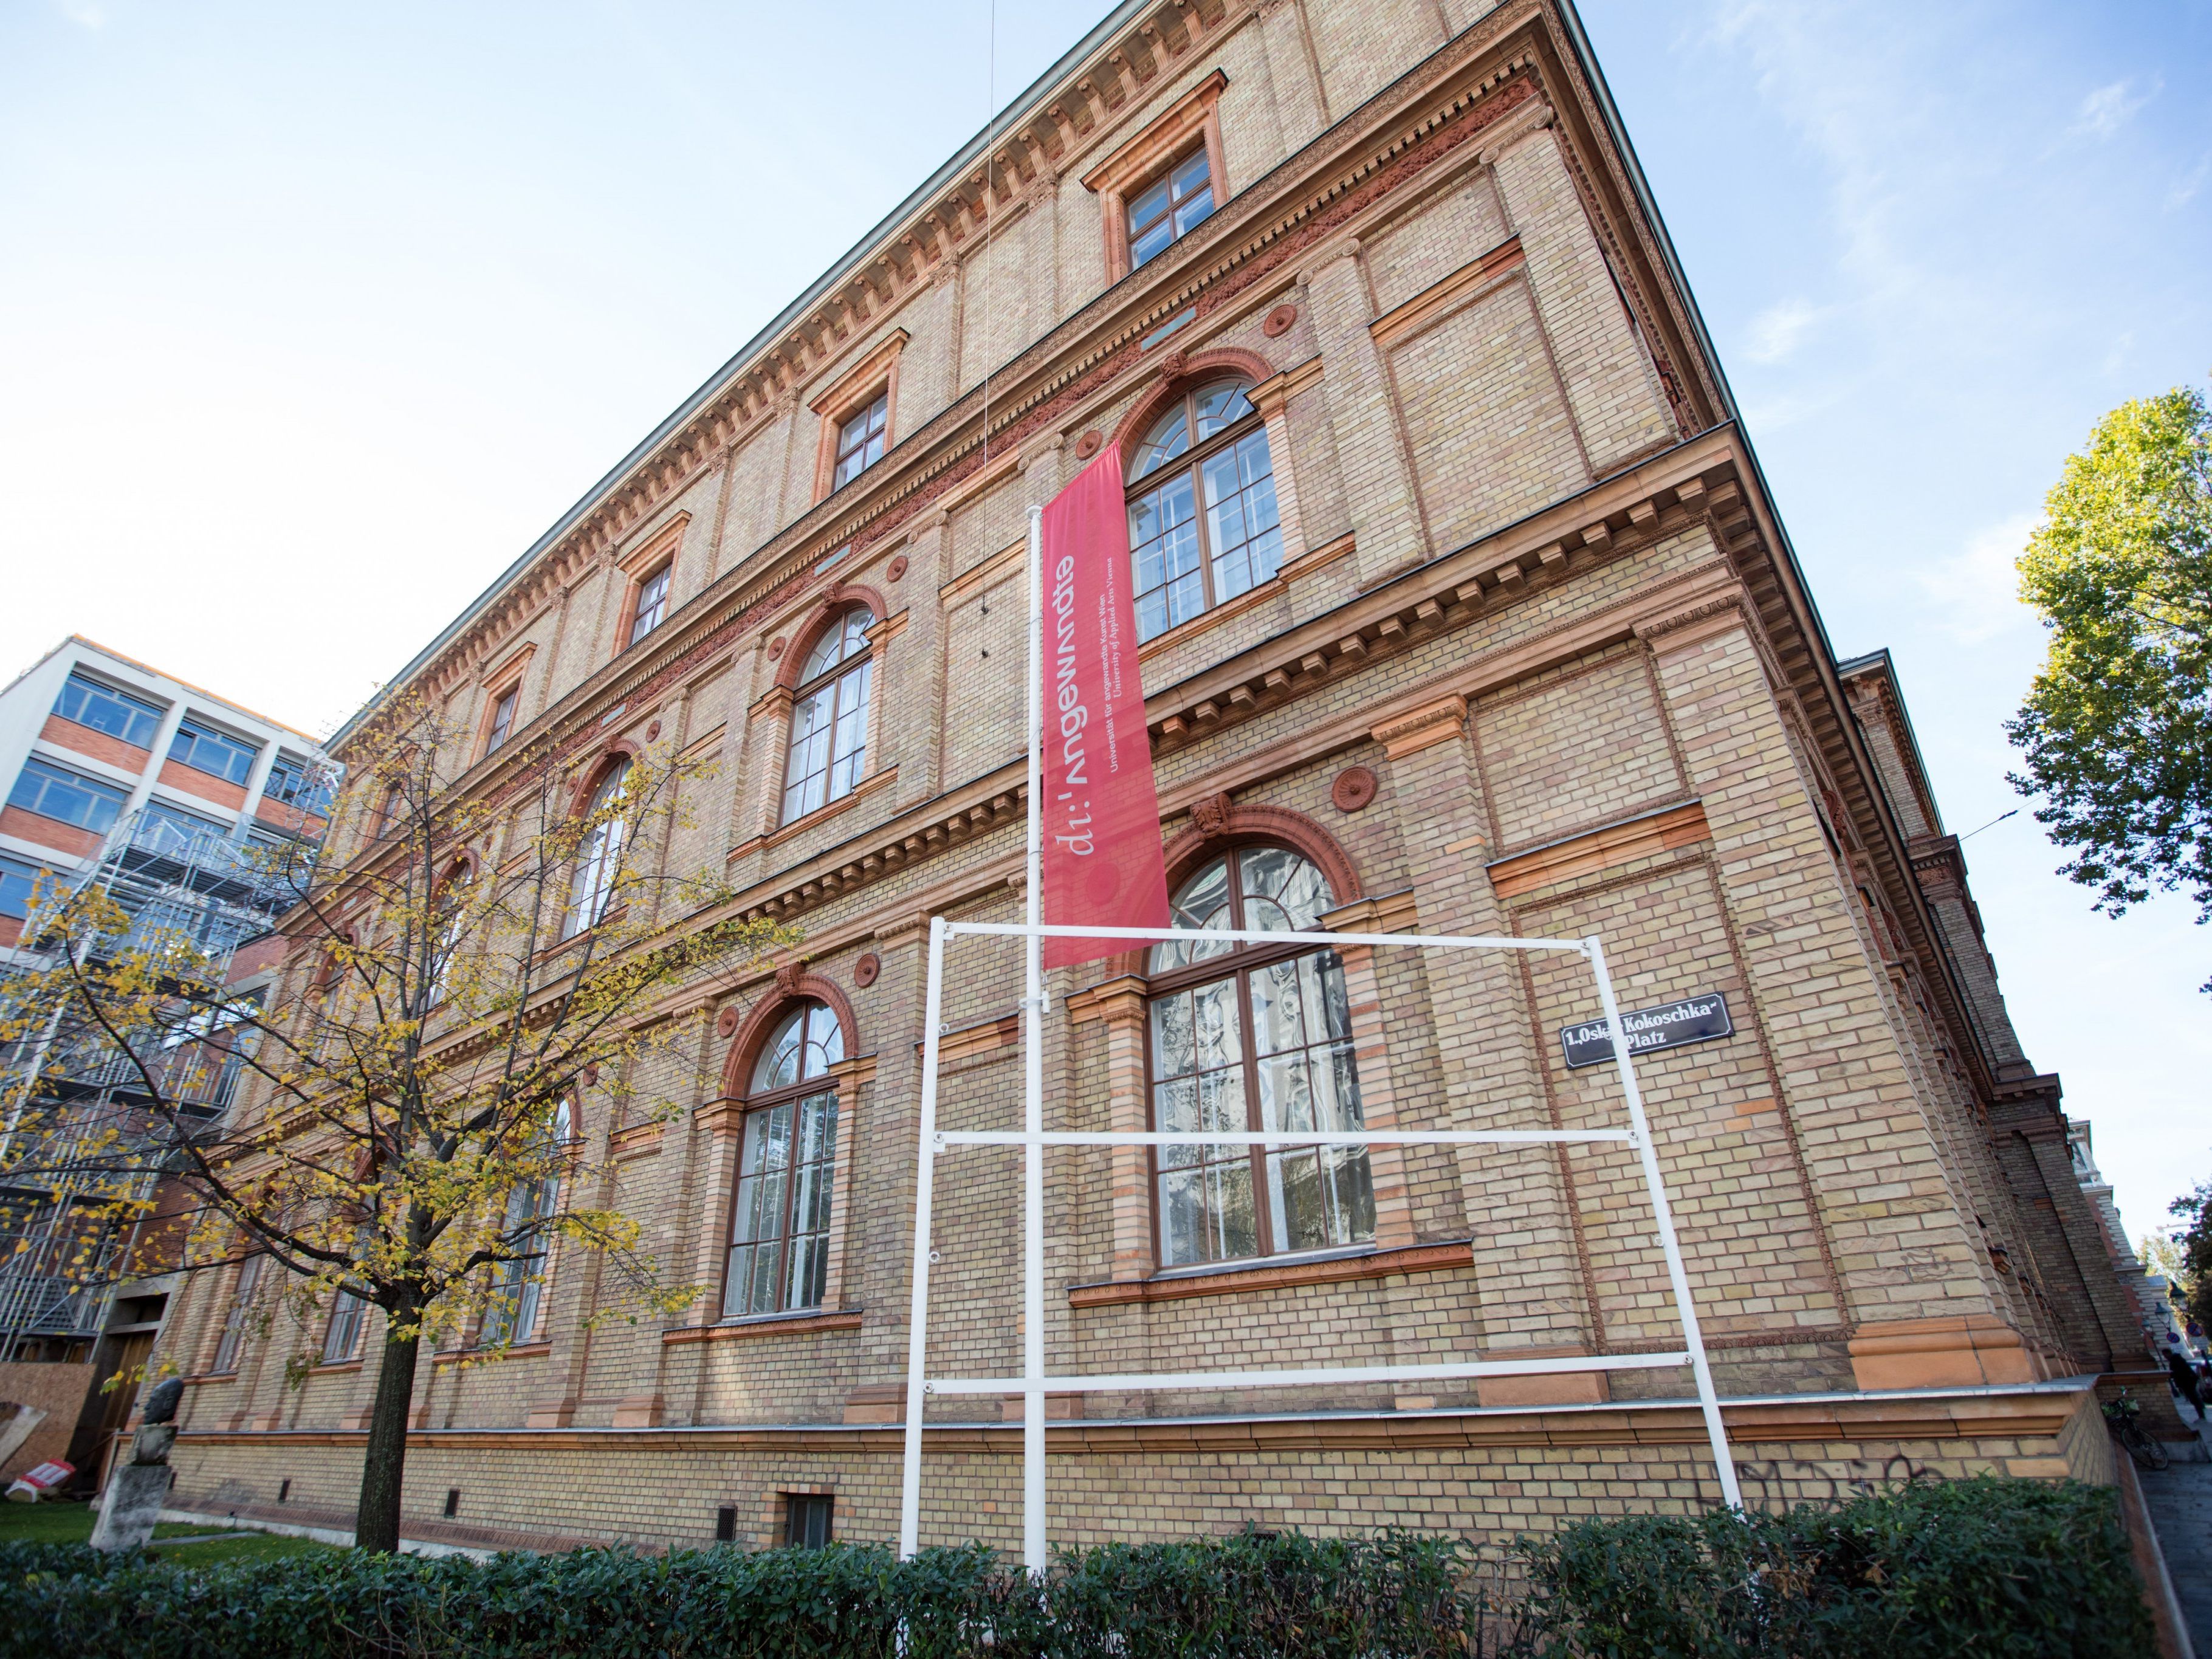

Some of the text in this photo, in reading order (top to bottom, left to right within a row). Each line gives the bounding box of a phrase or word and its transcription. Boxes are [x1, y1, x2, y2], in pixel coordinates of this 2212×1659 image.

[1099, 617, 1108, 644] Kunst
[1108, 606, 1119, 639] Applied
[1109, 639, 1119, 650] of
[1101, 645, 1112, 701] angewandte
[1111, 652, 1122, 698] University
[1106, 718, 1119, 773] Universität
[1627, 1031, 1666, 1050] Platz
